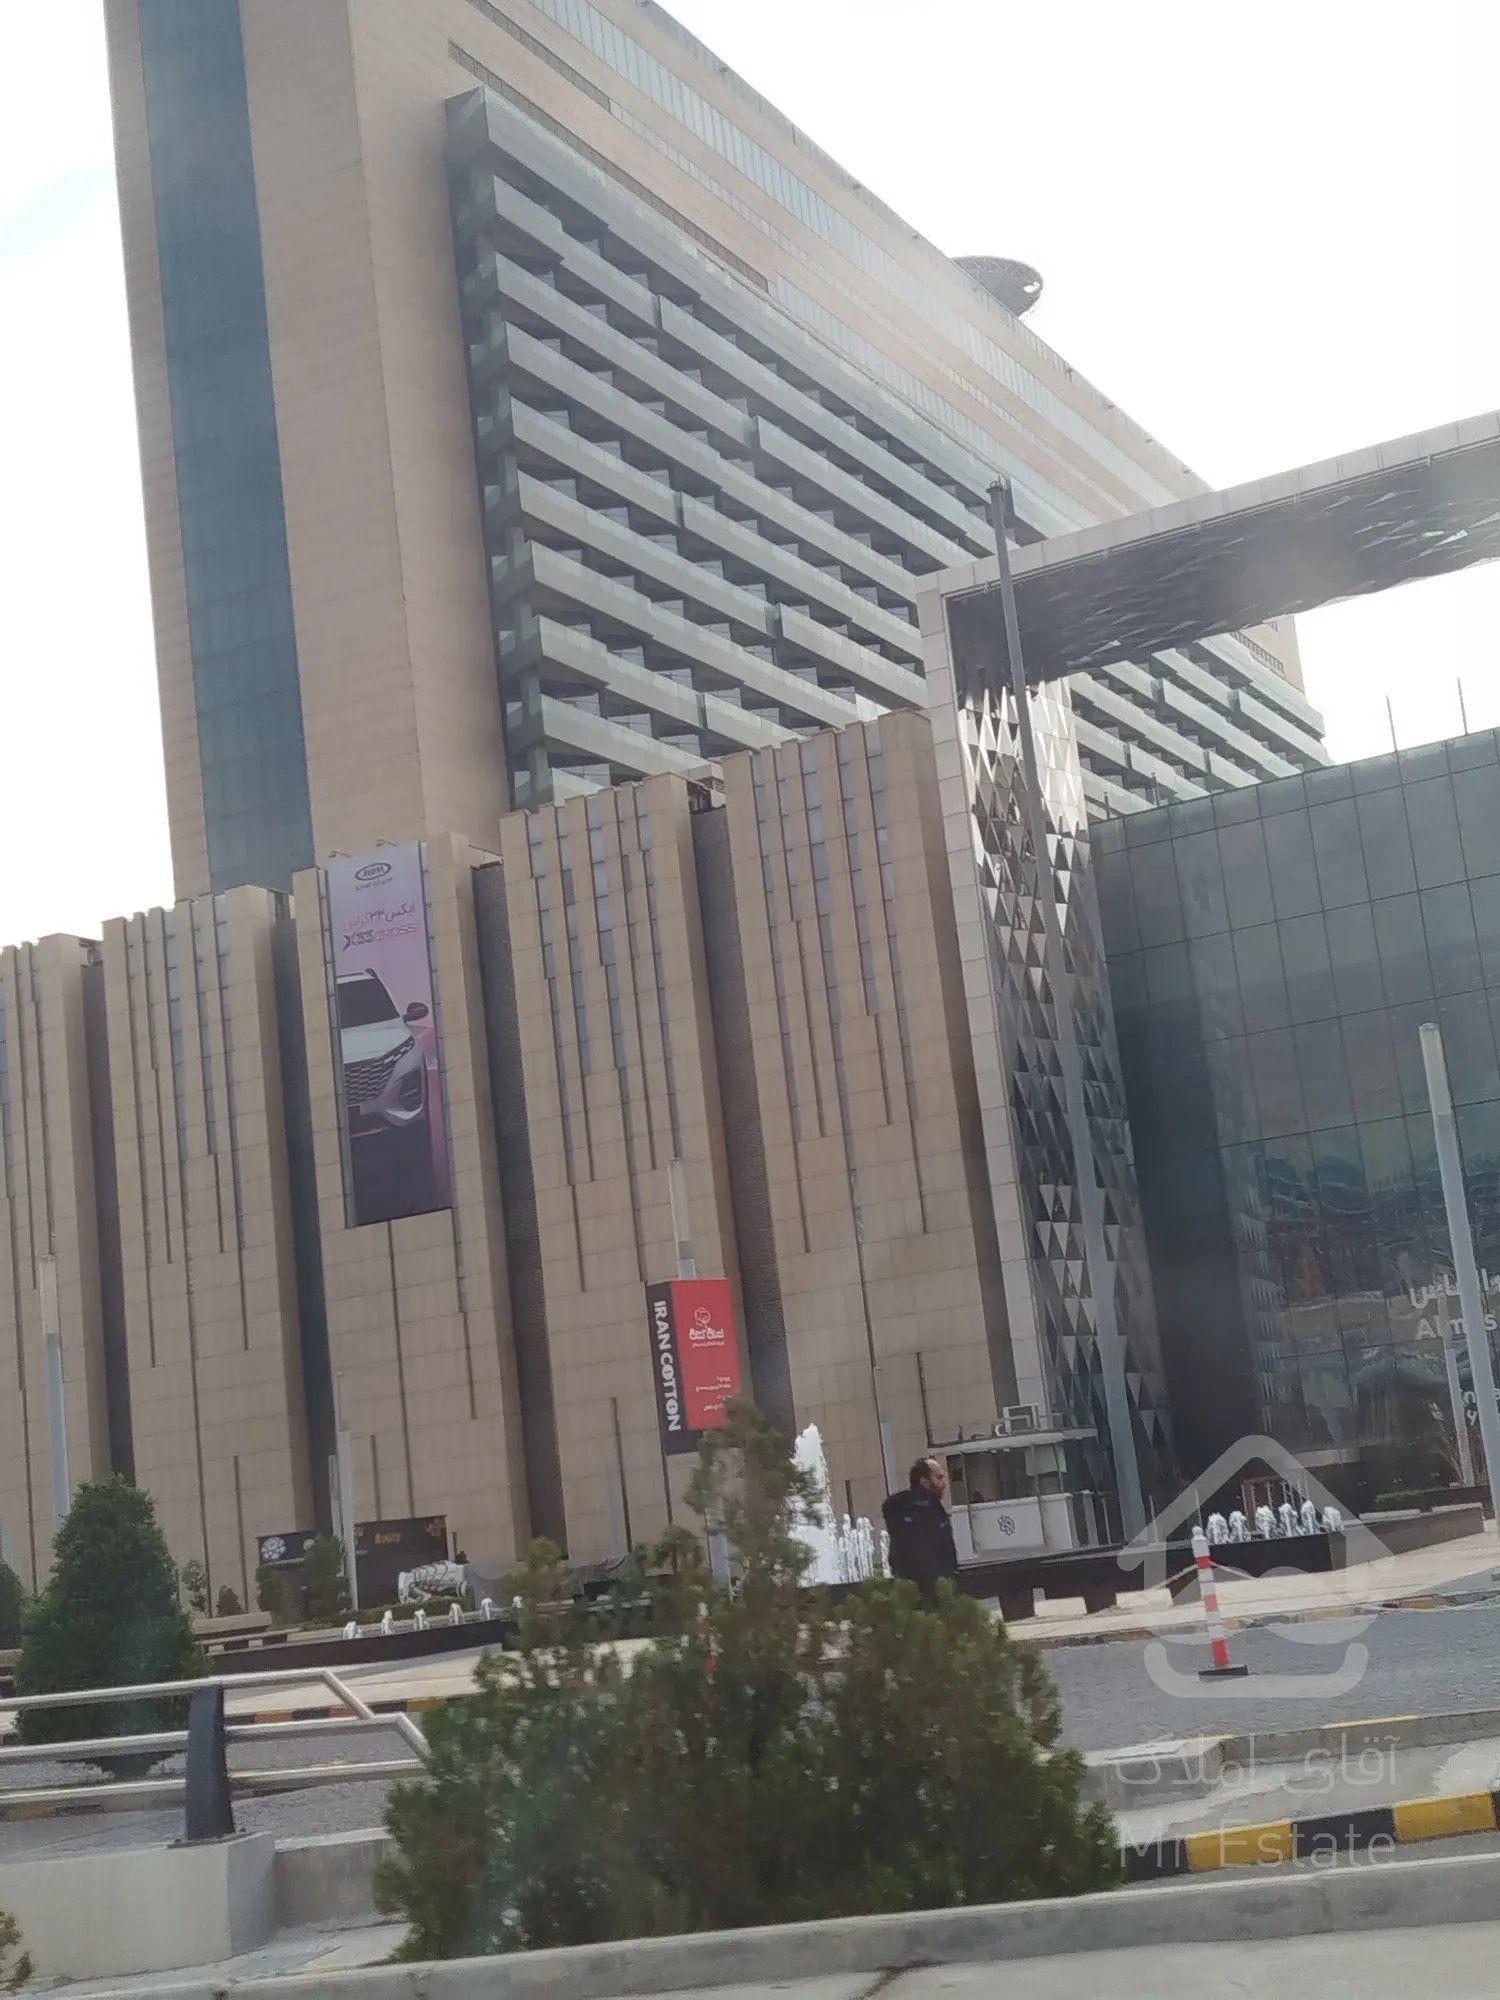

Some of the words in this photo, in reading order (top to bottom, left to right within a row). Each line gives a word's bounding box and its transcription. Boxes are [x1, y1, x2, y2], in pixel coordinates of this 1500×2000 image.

[653, 1300, 672, 1350] IRAN
[1416, 1313, 1498, 1341] Alms
[660, 1352, 682, 1432] COTTON
